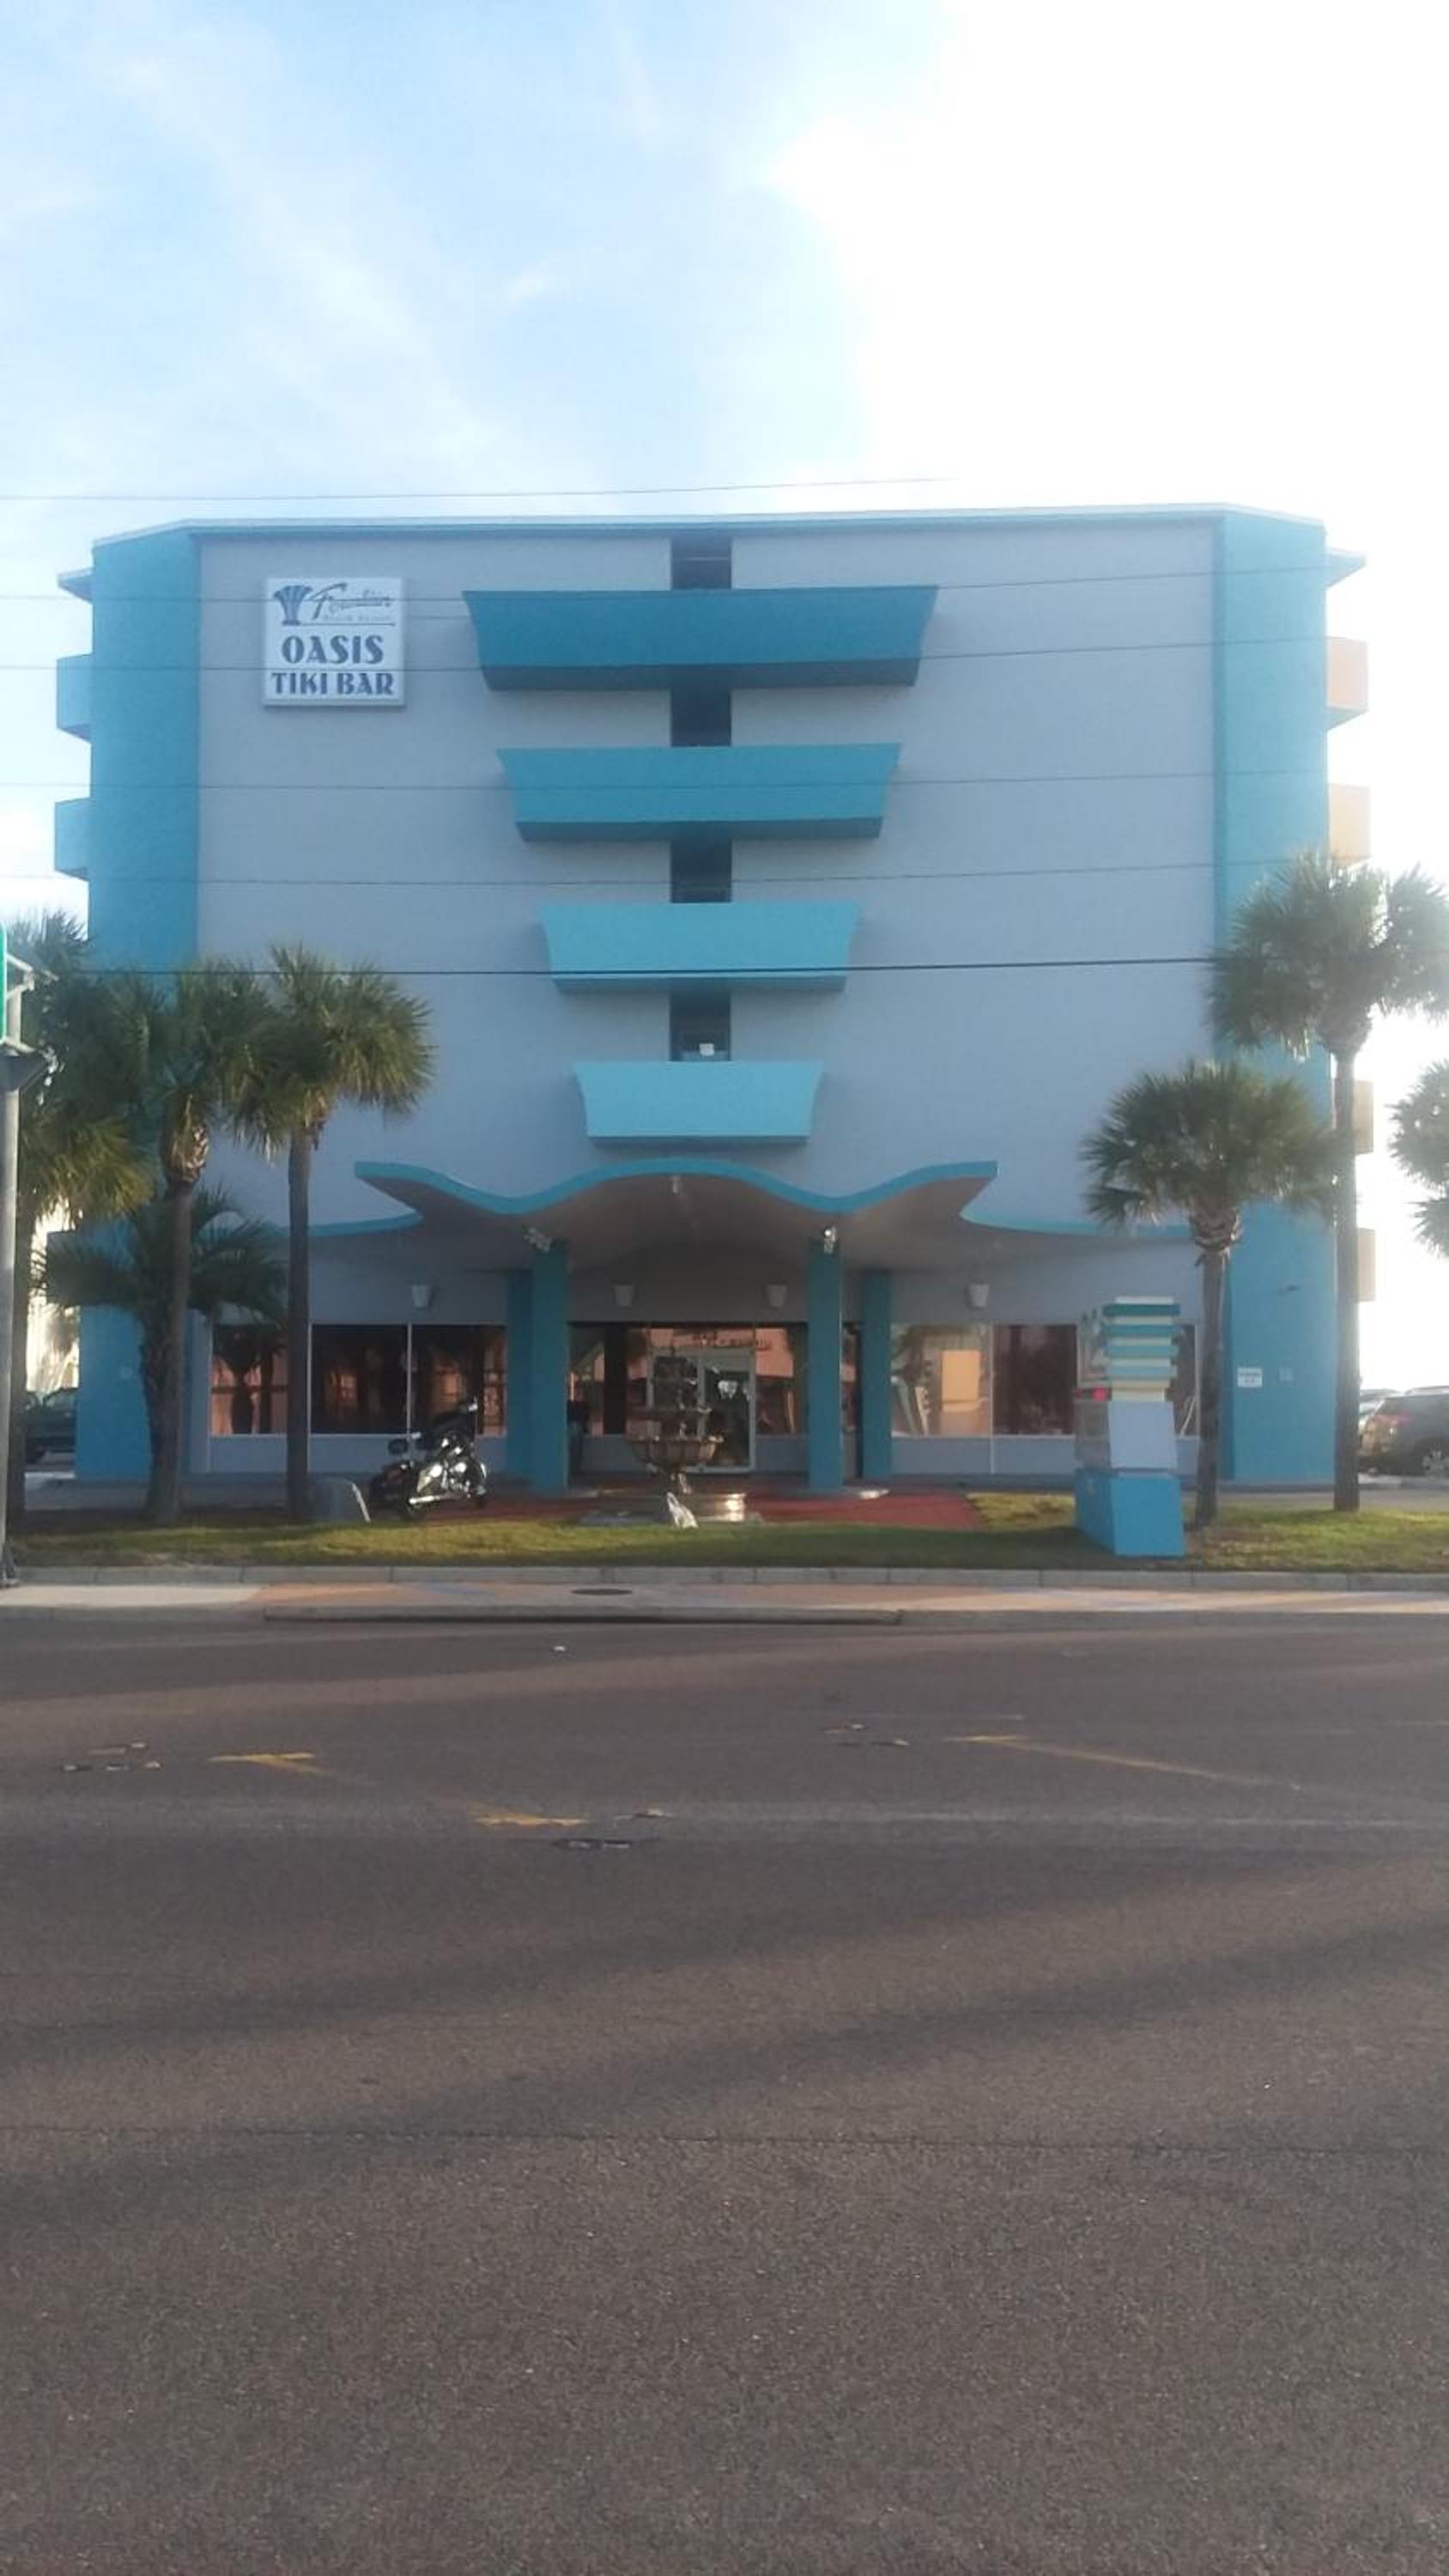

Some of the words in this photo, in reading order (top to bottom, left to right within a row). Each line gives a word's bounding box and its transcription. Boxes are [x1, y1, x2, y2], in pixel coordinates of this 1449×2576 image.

[281, 635, 384, 665] OASIS
[271, 672, 328, 695] TIKI
[336, 672, 394, 696] BAR
